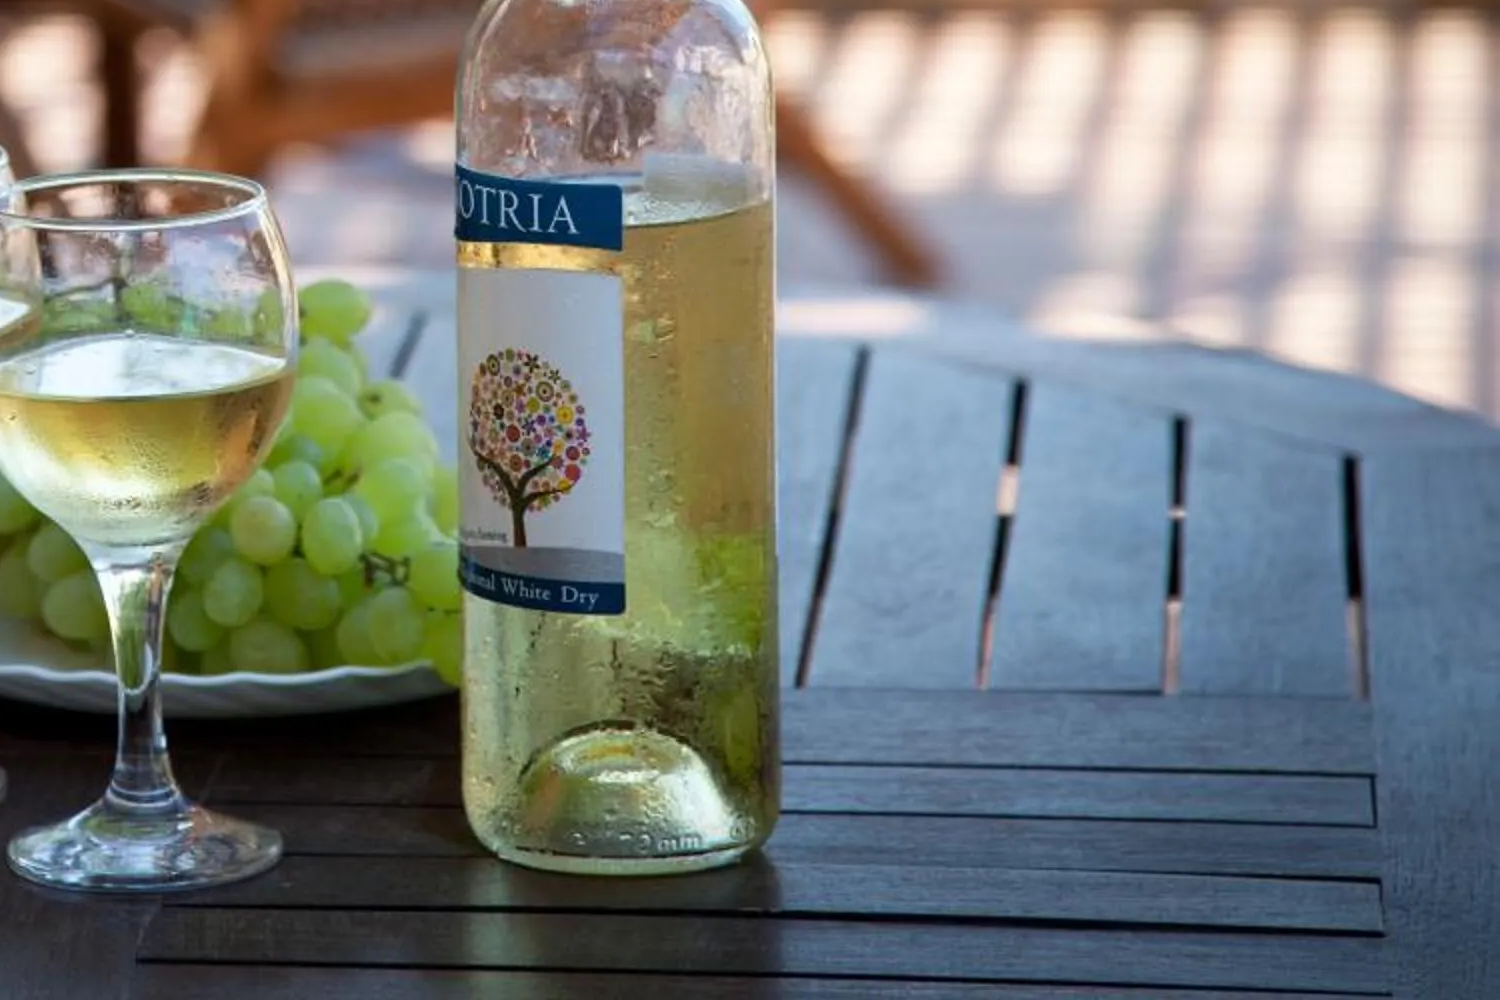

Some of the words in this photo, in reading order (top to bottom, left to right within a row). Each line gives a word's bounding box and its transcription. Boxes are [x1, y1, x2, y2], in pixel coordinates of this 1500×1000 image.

[459, 179, 580, 235] OTRIA
[501, 577, 551, 601] White
[561, 585, 599, 610] Dry
